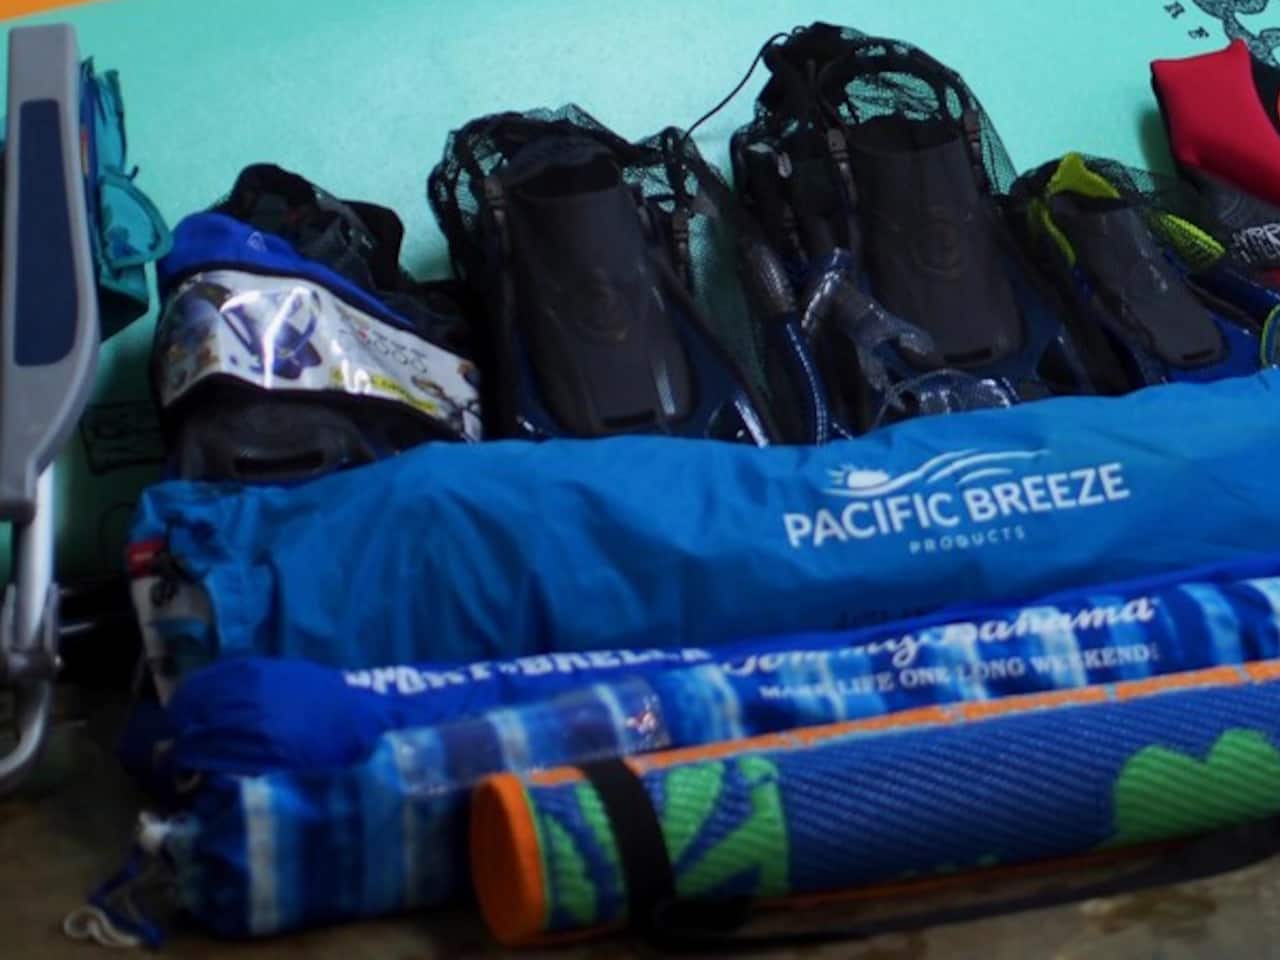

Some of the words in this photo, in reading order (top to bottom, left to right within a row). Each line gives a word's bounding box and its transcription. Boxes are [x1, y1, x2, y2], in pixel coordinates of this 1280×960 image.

[784, 492, 959, 548] PACIFIC
[965, 463, 1131, 522] BREEZE
[909, 525, 1026, 554] PRODUCTS
